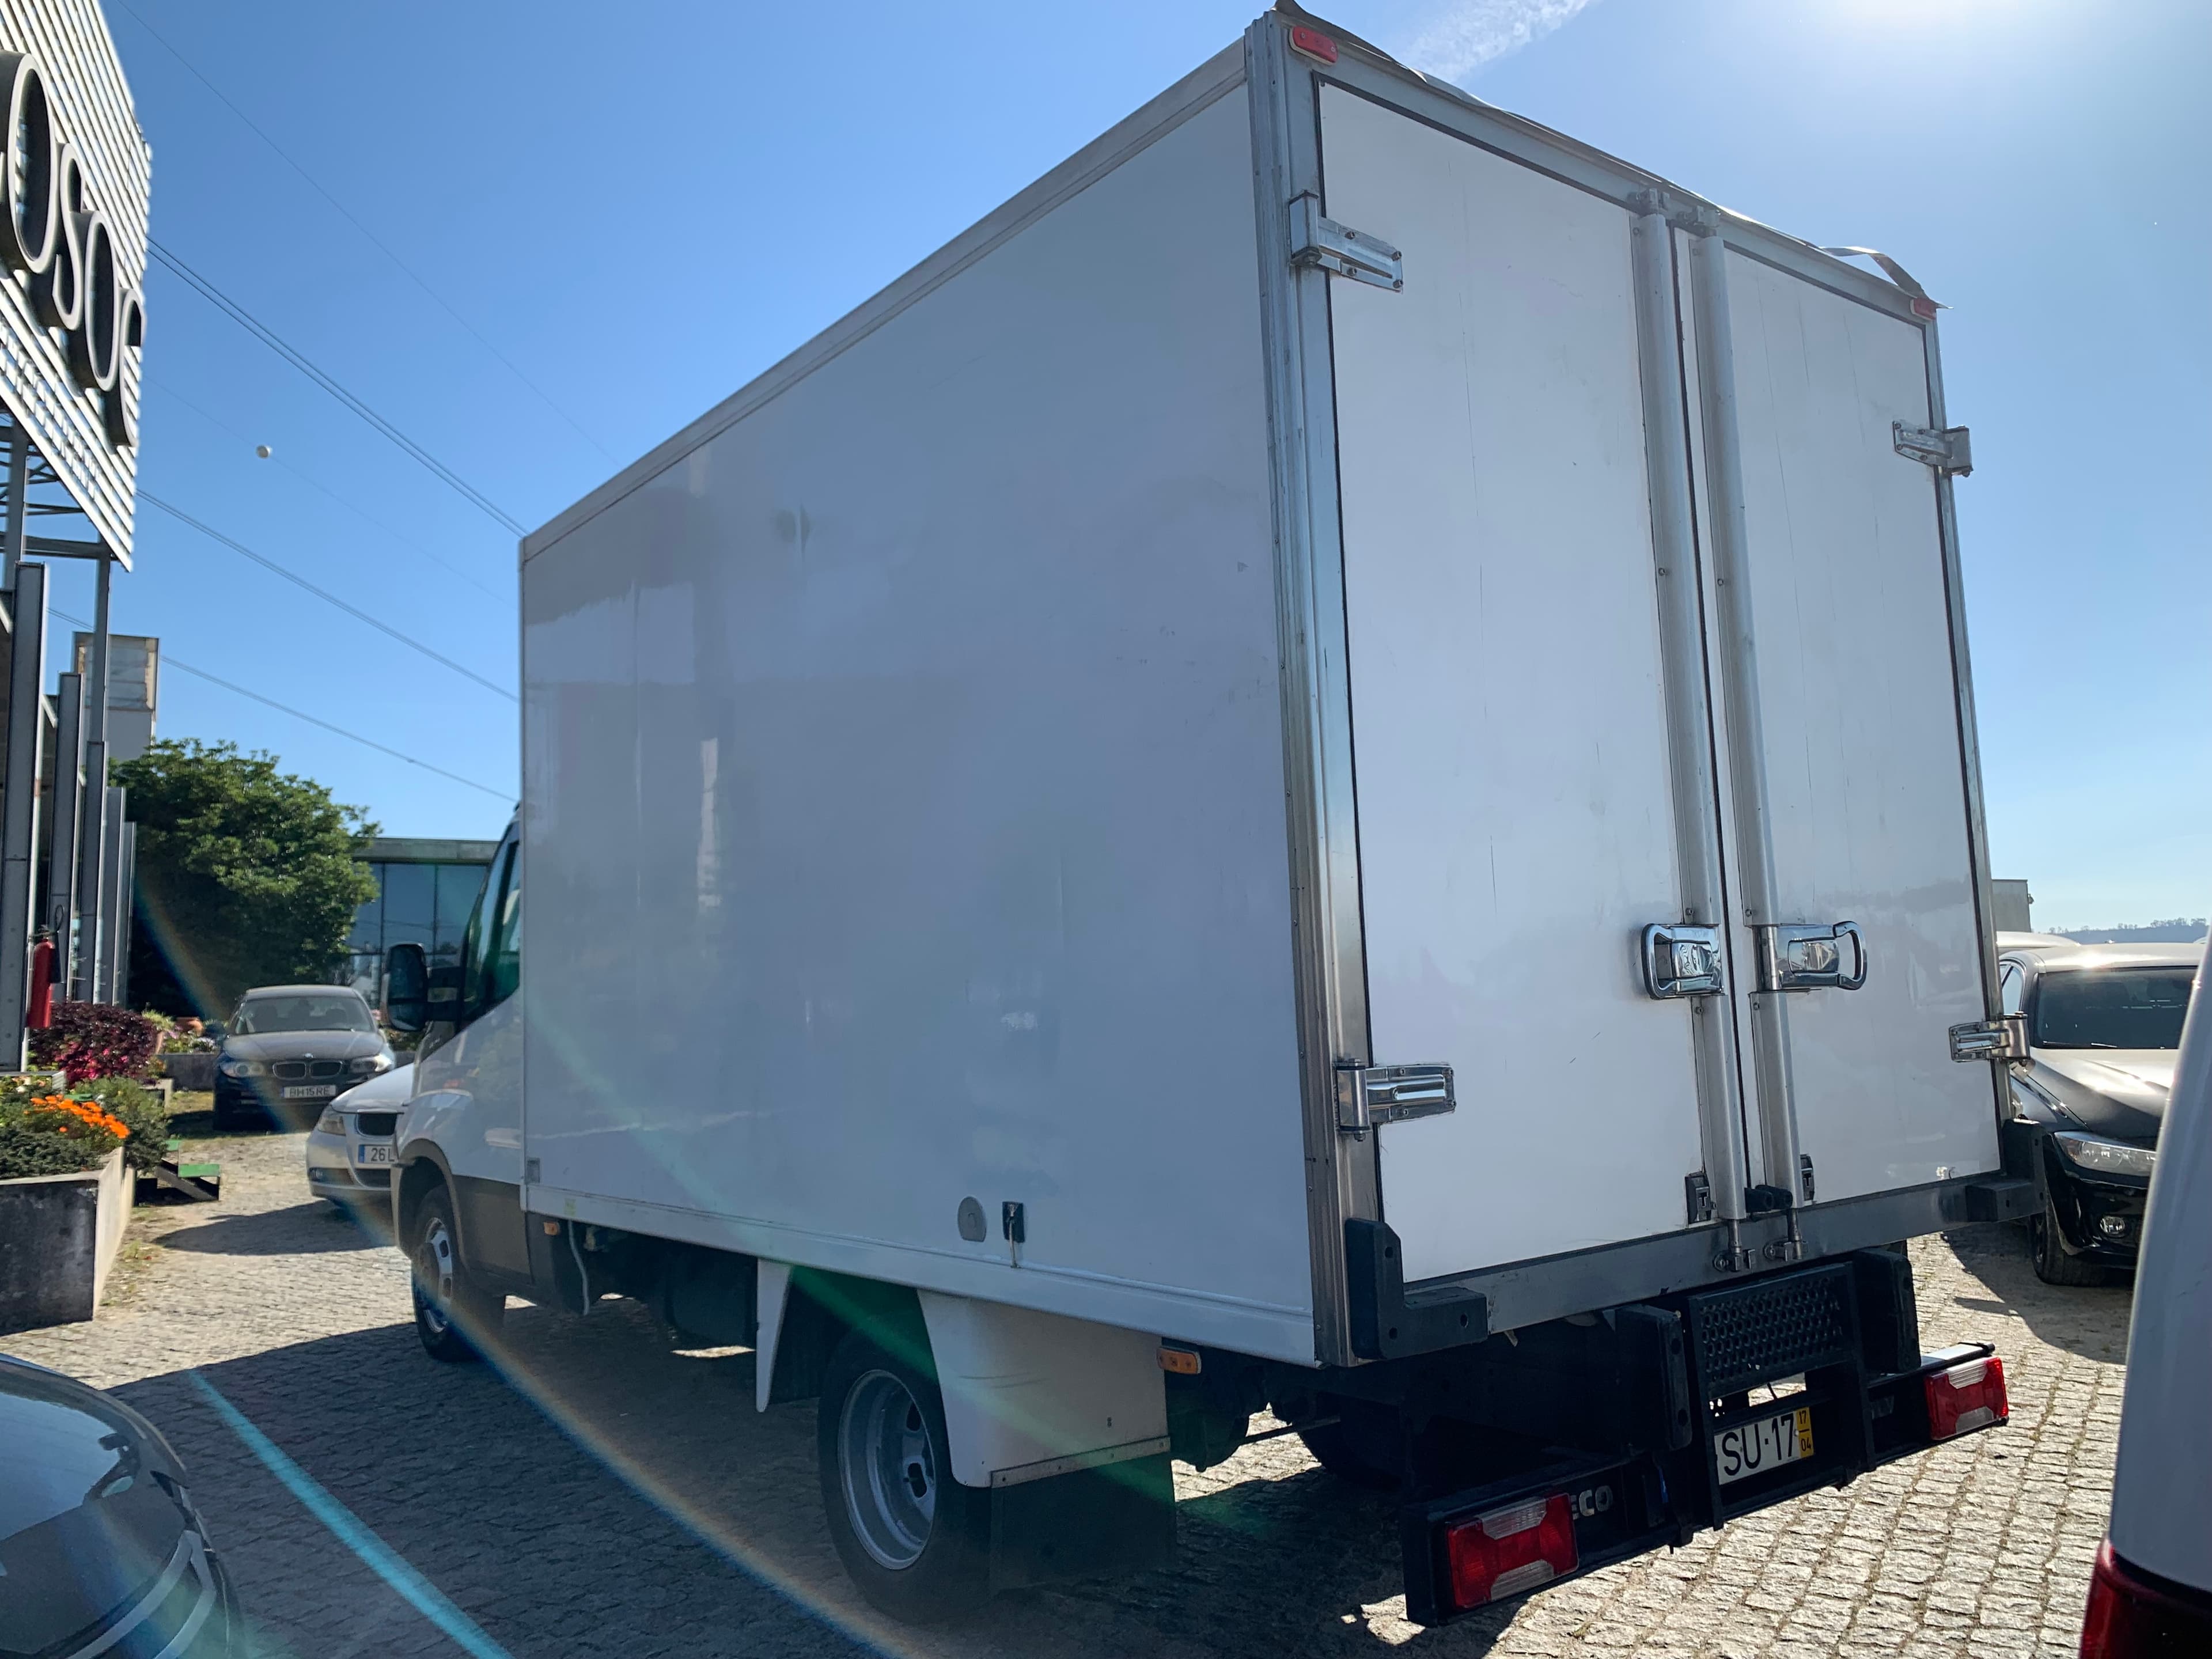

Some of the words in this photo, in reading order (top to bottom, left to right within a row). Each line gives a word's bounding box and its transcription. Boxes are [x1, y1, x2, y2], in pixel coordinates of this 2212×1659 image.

[388, 1147, 395, 1162] L
[1799, 1410, 1806, 1424] 17
[1801, 1437, 1812, 1452] 04
